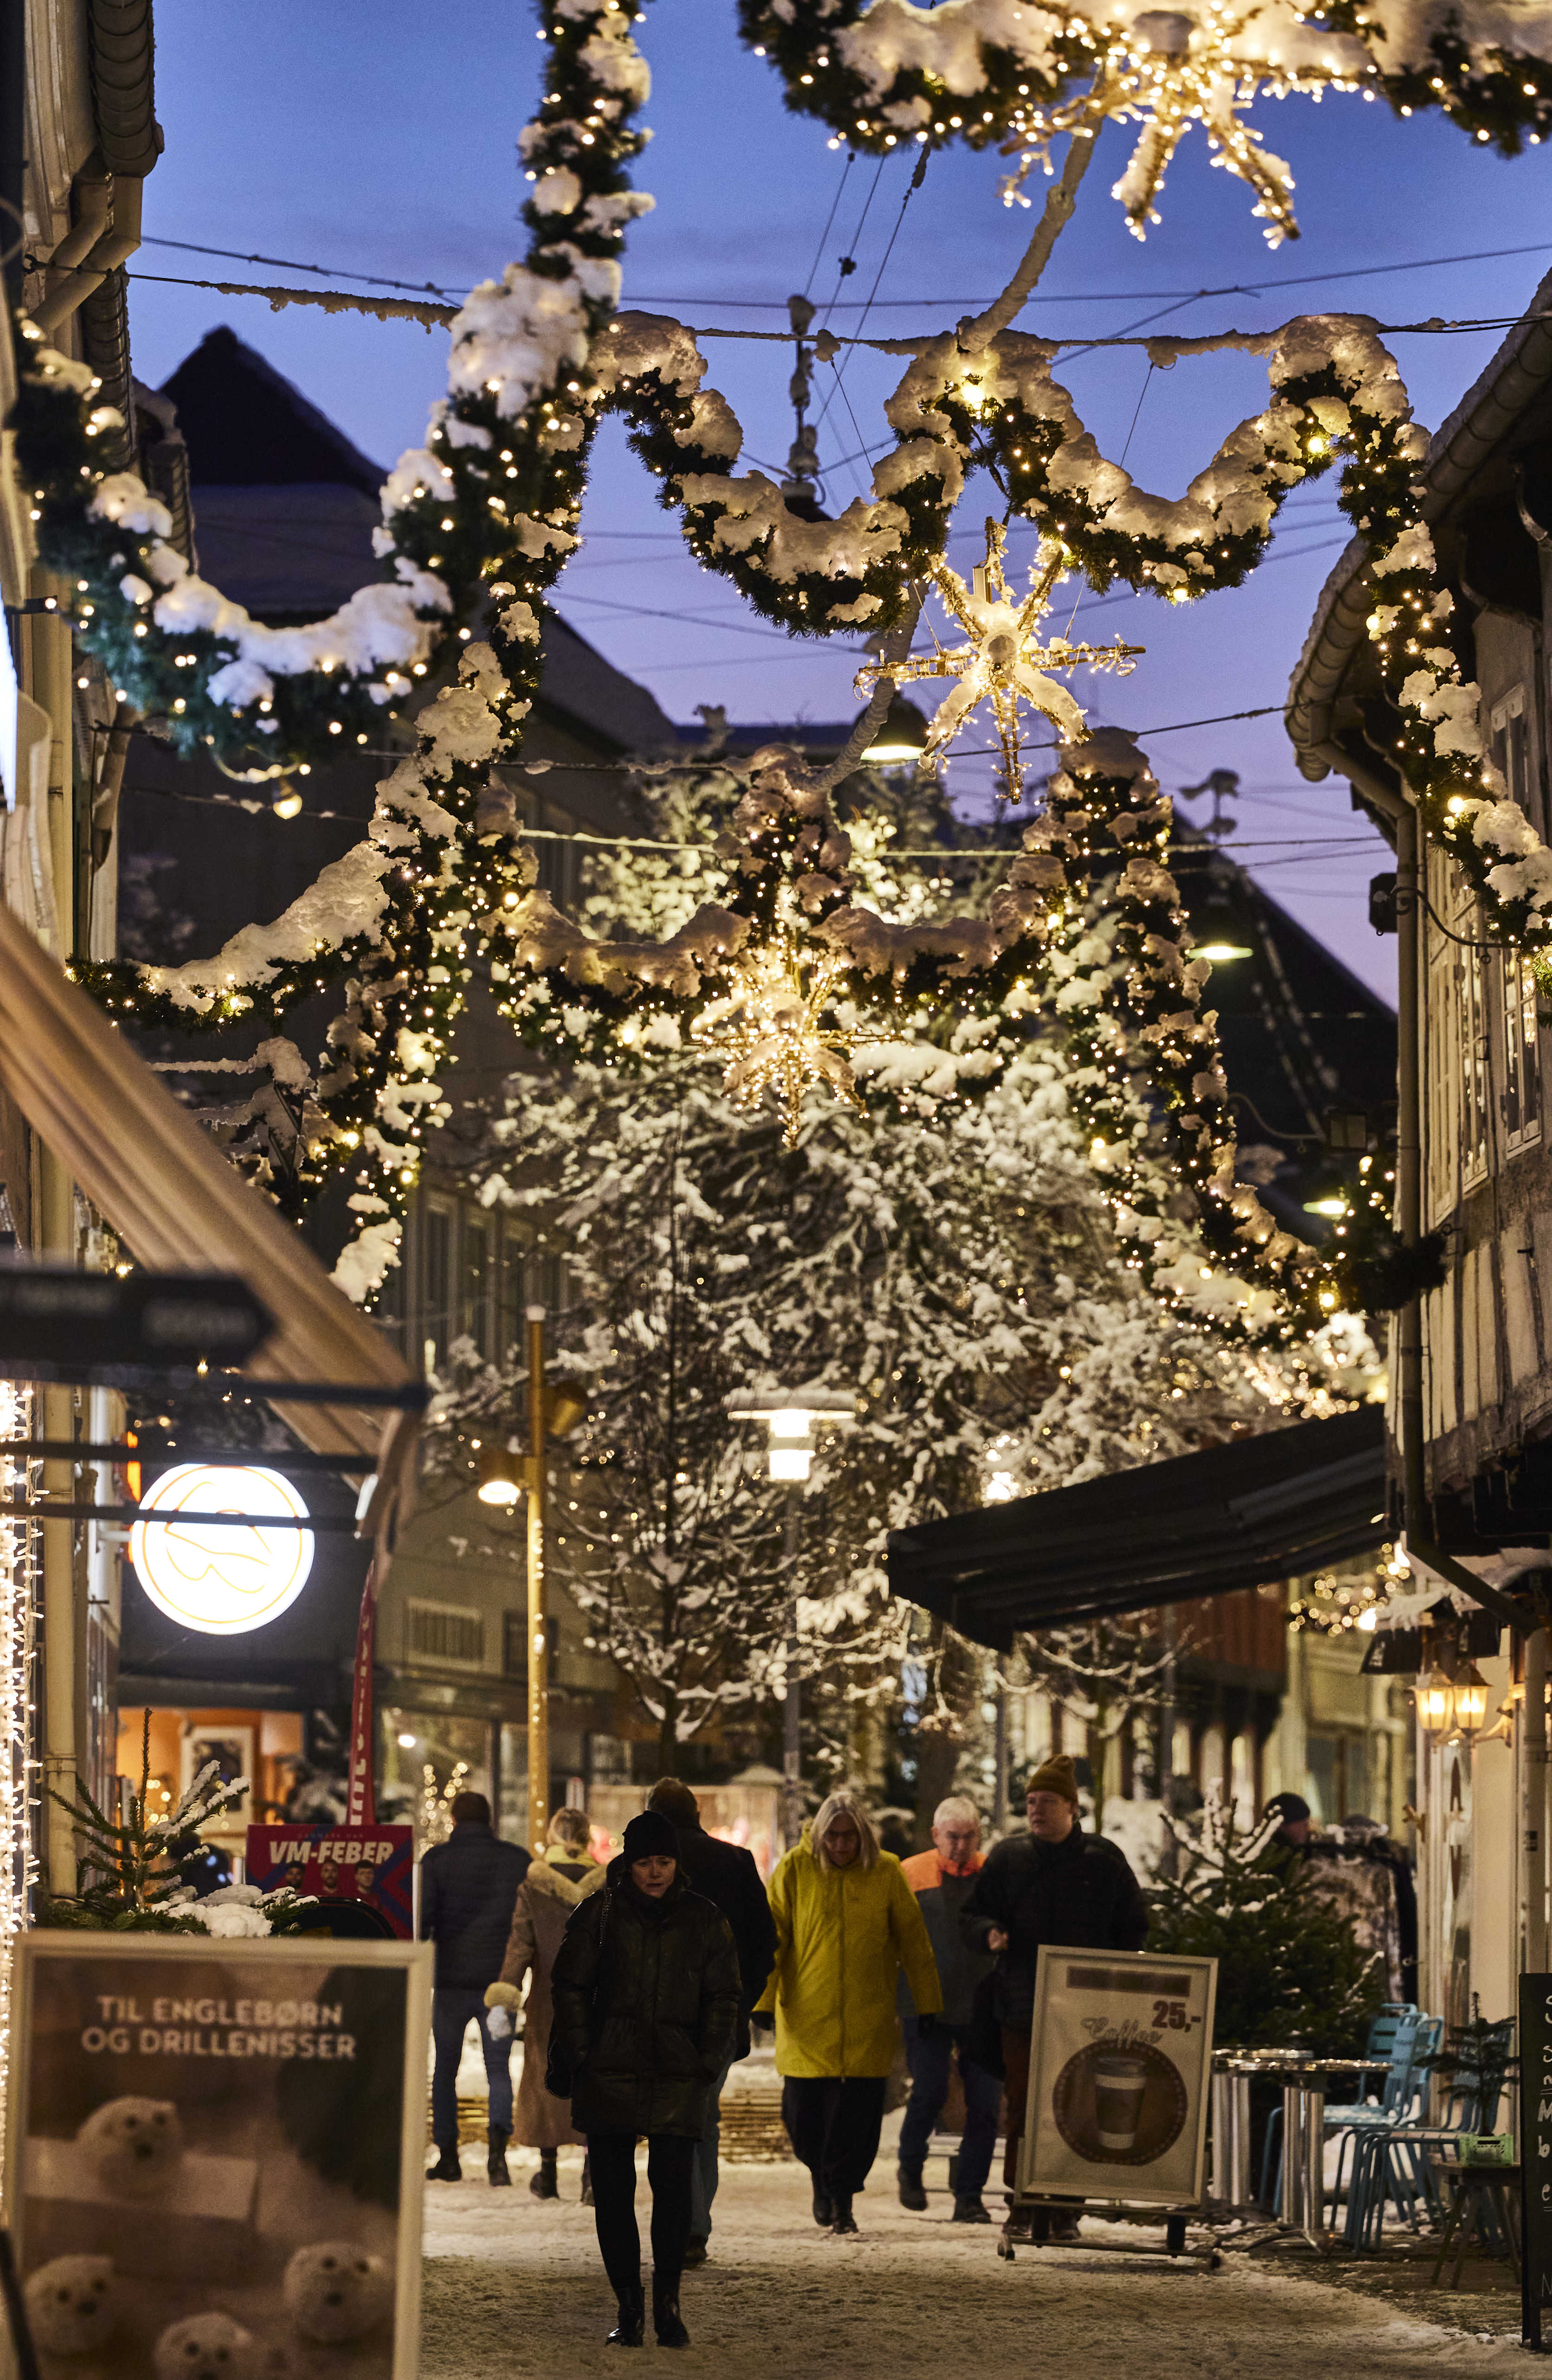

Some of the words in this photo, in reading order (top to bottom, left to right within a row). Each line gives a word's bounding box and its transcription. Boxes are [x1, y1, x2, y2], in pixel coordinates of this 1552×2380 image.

[269, 1841, 393, 1864] VM-FEBER
[98, 1996, 141, 2022] TIL
[153, 1998, 342, 2027] ENGLEBØRN
[1152, 2001, 1200, 2032] 25,-
[82, 2027, 130, 2054] OG
[140, 2029, 356, 2059] DRILLENISSER
[1081, 2017, 1163, 2049] Coffee
